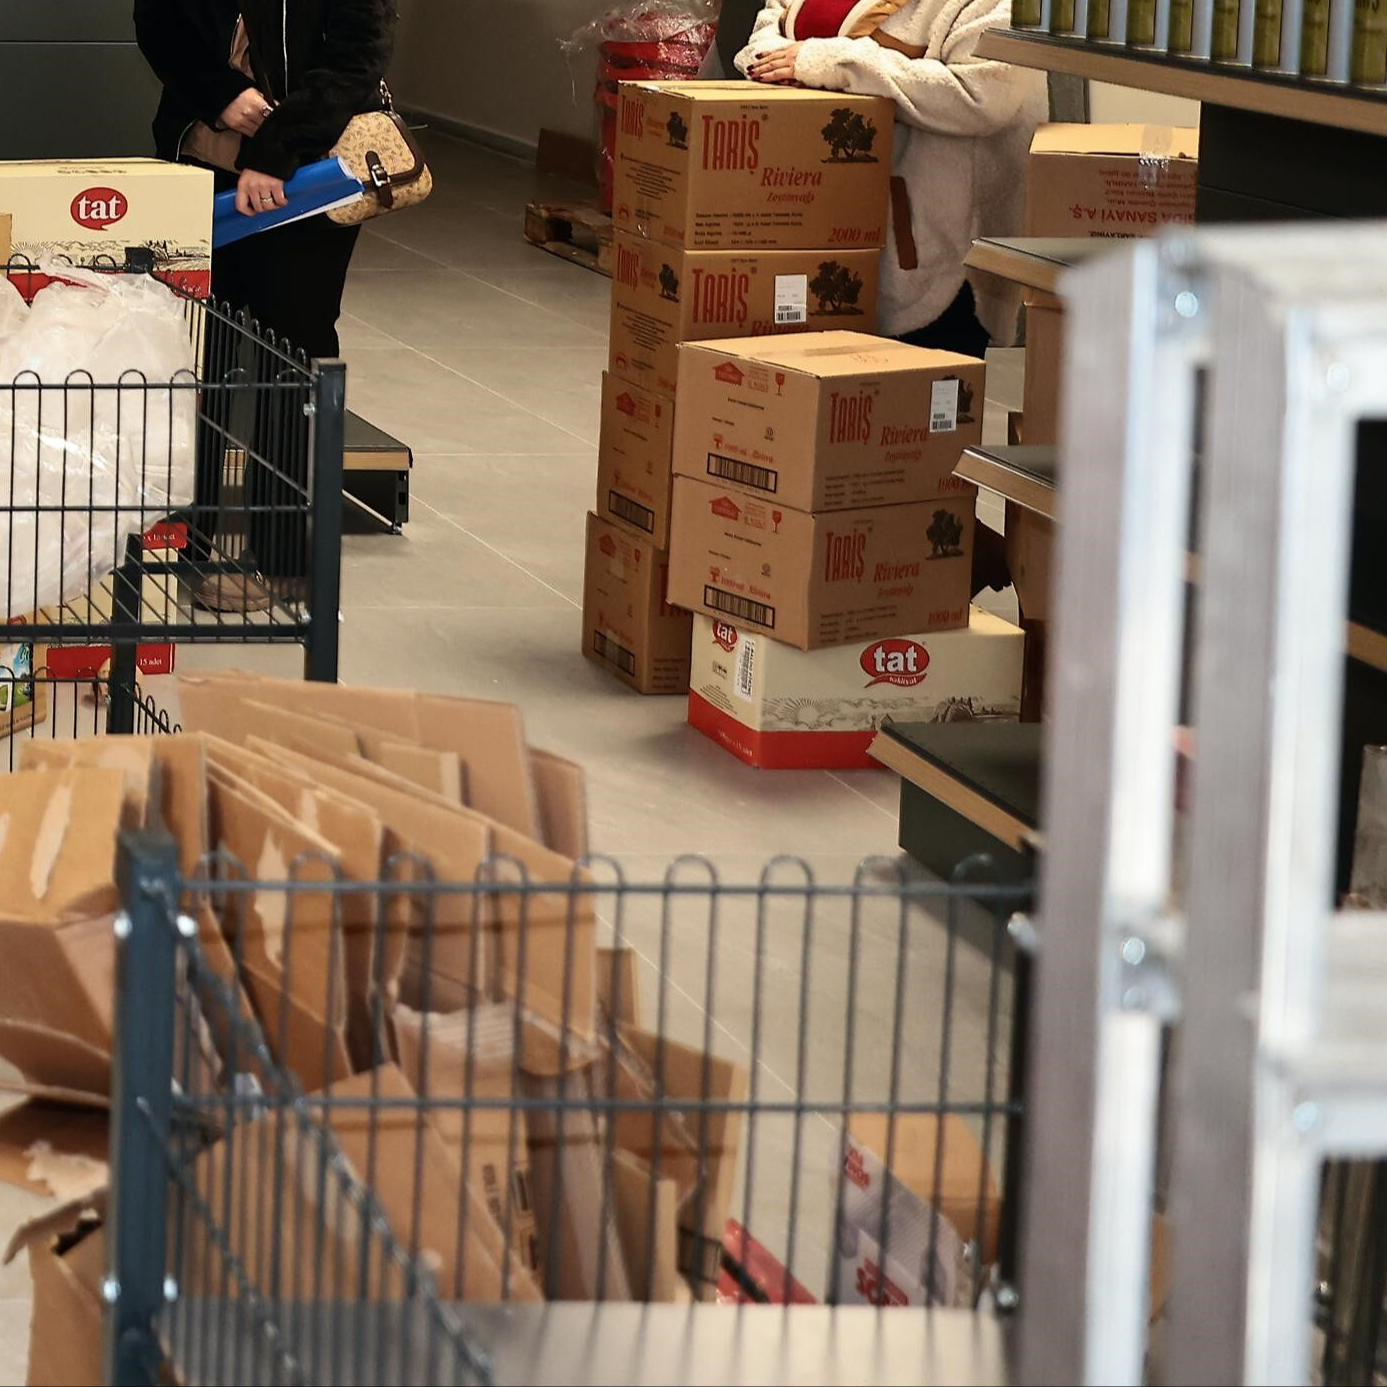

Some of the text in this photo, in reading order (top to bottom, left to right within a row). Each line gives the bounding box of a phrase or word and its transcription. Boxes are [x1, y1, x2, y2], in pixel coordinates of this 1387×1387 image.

[702, 114, 761, 175] TARİŞ
[761, 167, 821, 187] Riviera
[78, 196, 121, 220] tat
[1102, 209, 1157, 223] SANAYİ
[828, 227, 861, 243] 2000
[692, 268, 749, 328] TARİŞ
[830, 391, 873, 445] TARİŞ
[881, 425, 928, 446] Riviera
[826, 530, 866, 582] TARİŞ
[874, 563, 919, 581] Riviera
[717, 622, 732, 644] tat
[874, 646, 918, 672] tat
